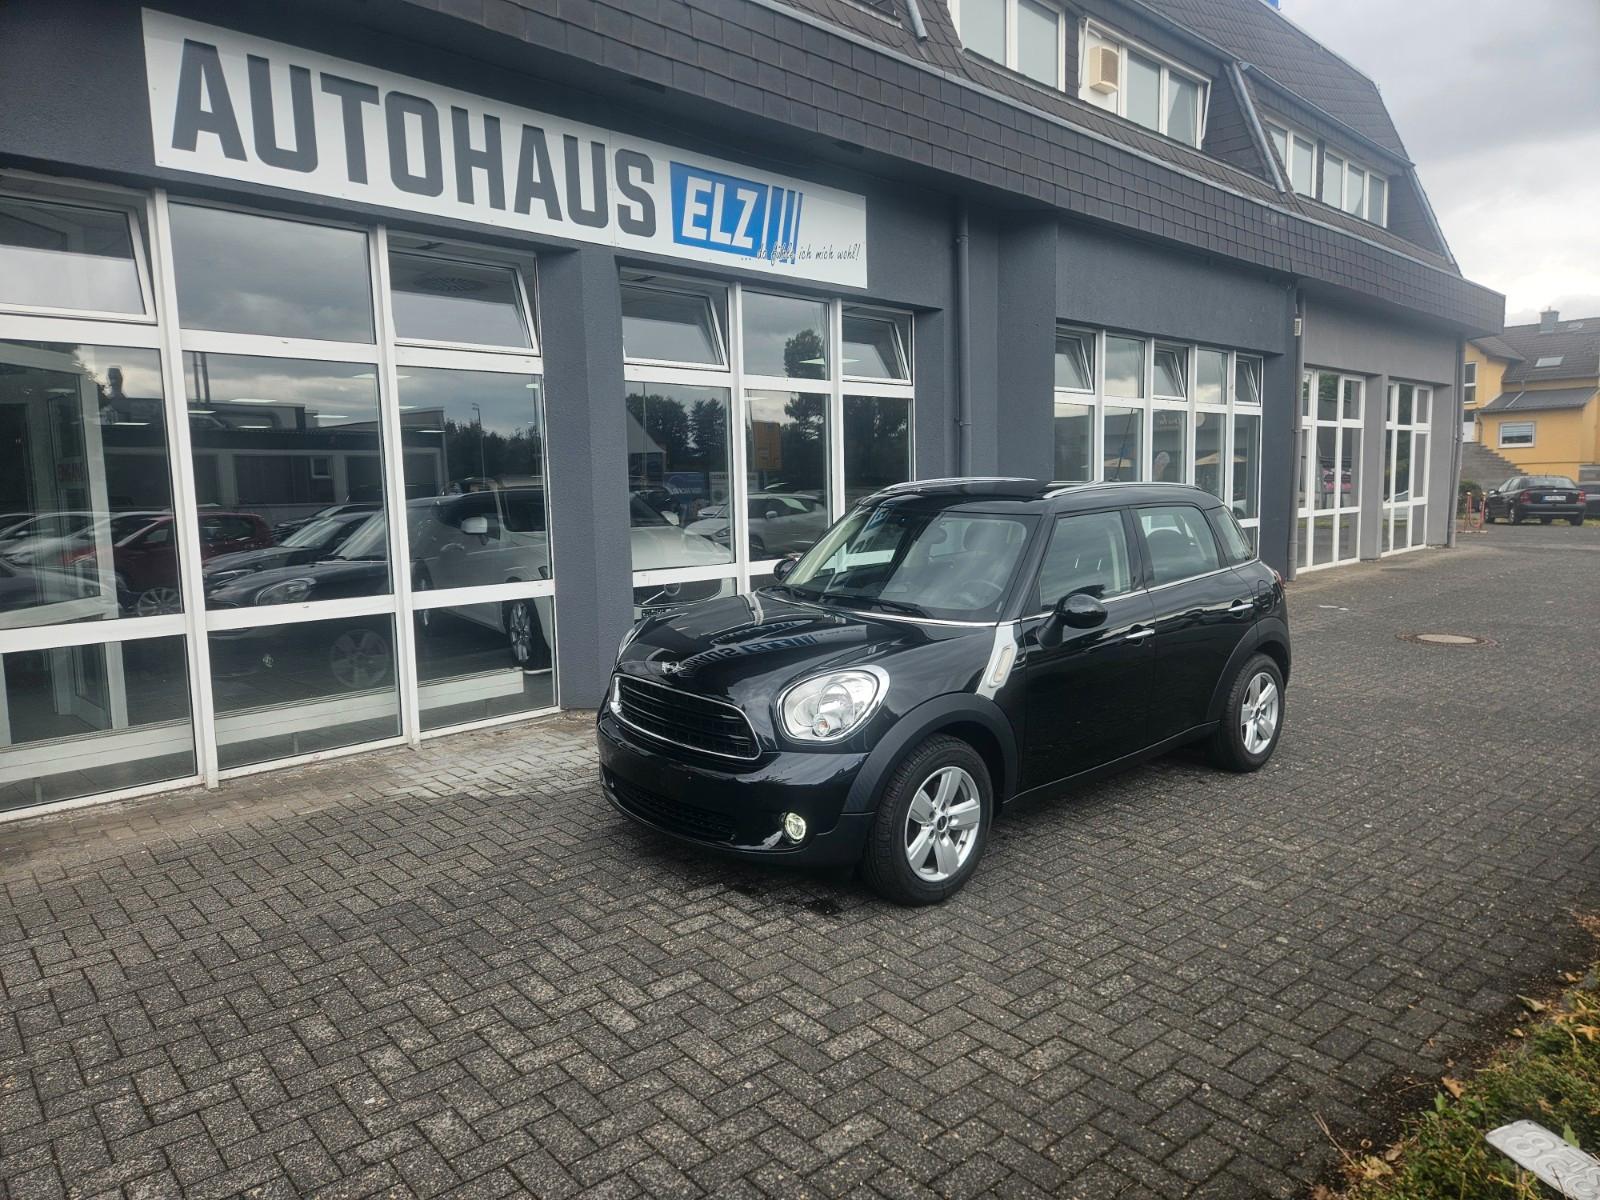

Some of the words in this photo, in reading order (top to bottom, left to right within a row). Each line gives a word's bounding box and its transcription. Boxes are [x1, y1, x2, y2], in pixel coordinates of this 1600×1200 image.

[171, 38, 657, 238] AUTOHAUS
[683, 176, 758, 249] ELZ
[798, 243, 811, 260] ich
[815, 244, 834, 260] mich
[837, 243, 861, 261] wohl!
